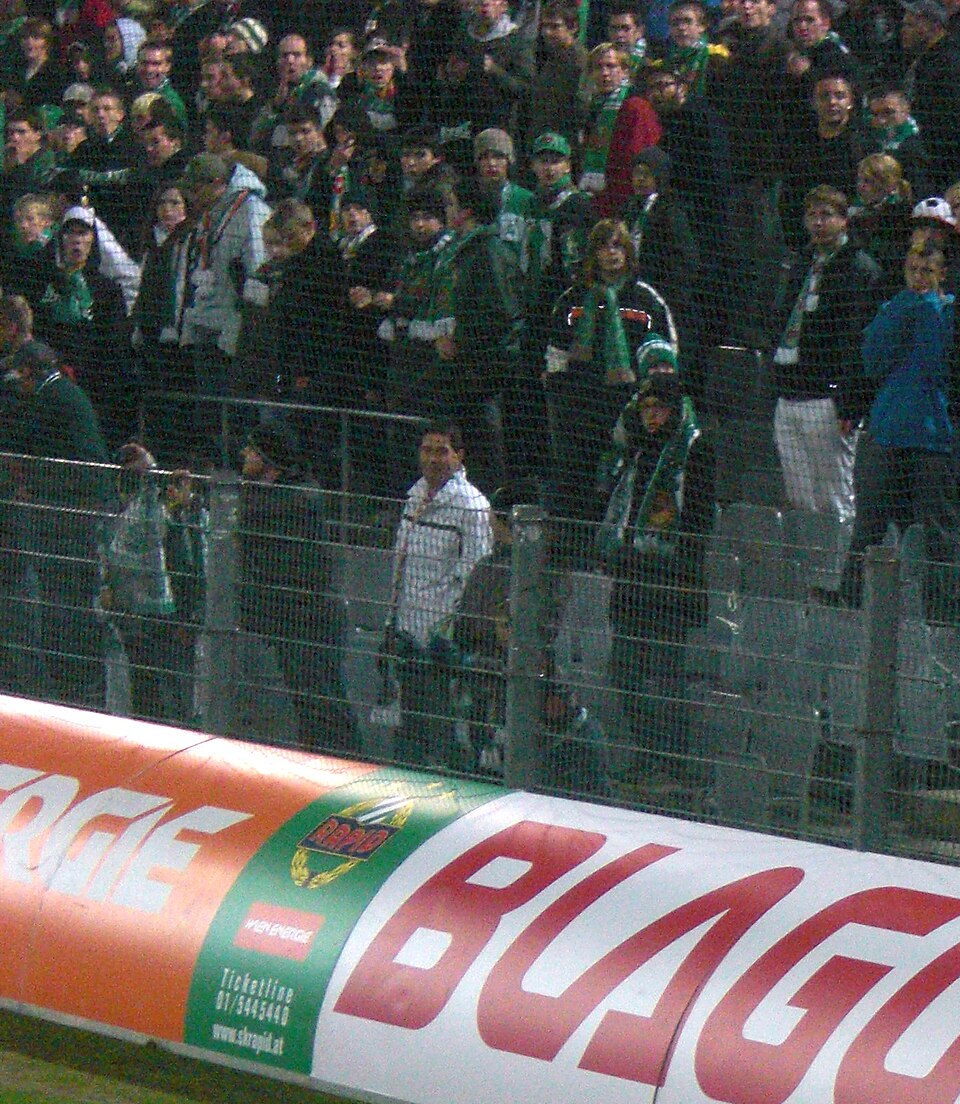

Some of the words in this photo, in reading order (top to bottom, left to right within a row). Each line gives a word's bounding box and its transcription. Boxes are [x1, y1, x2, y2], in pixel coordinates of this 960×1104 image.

[0, 763, 255, 913] RGIE
[309, 818, 389, 853] RAPID
[221, 967, 294, 1004] Ticketline
